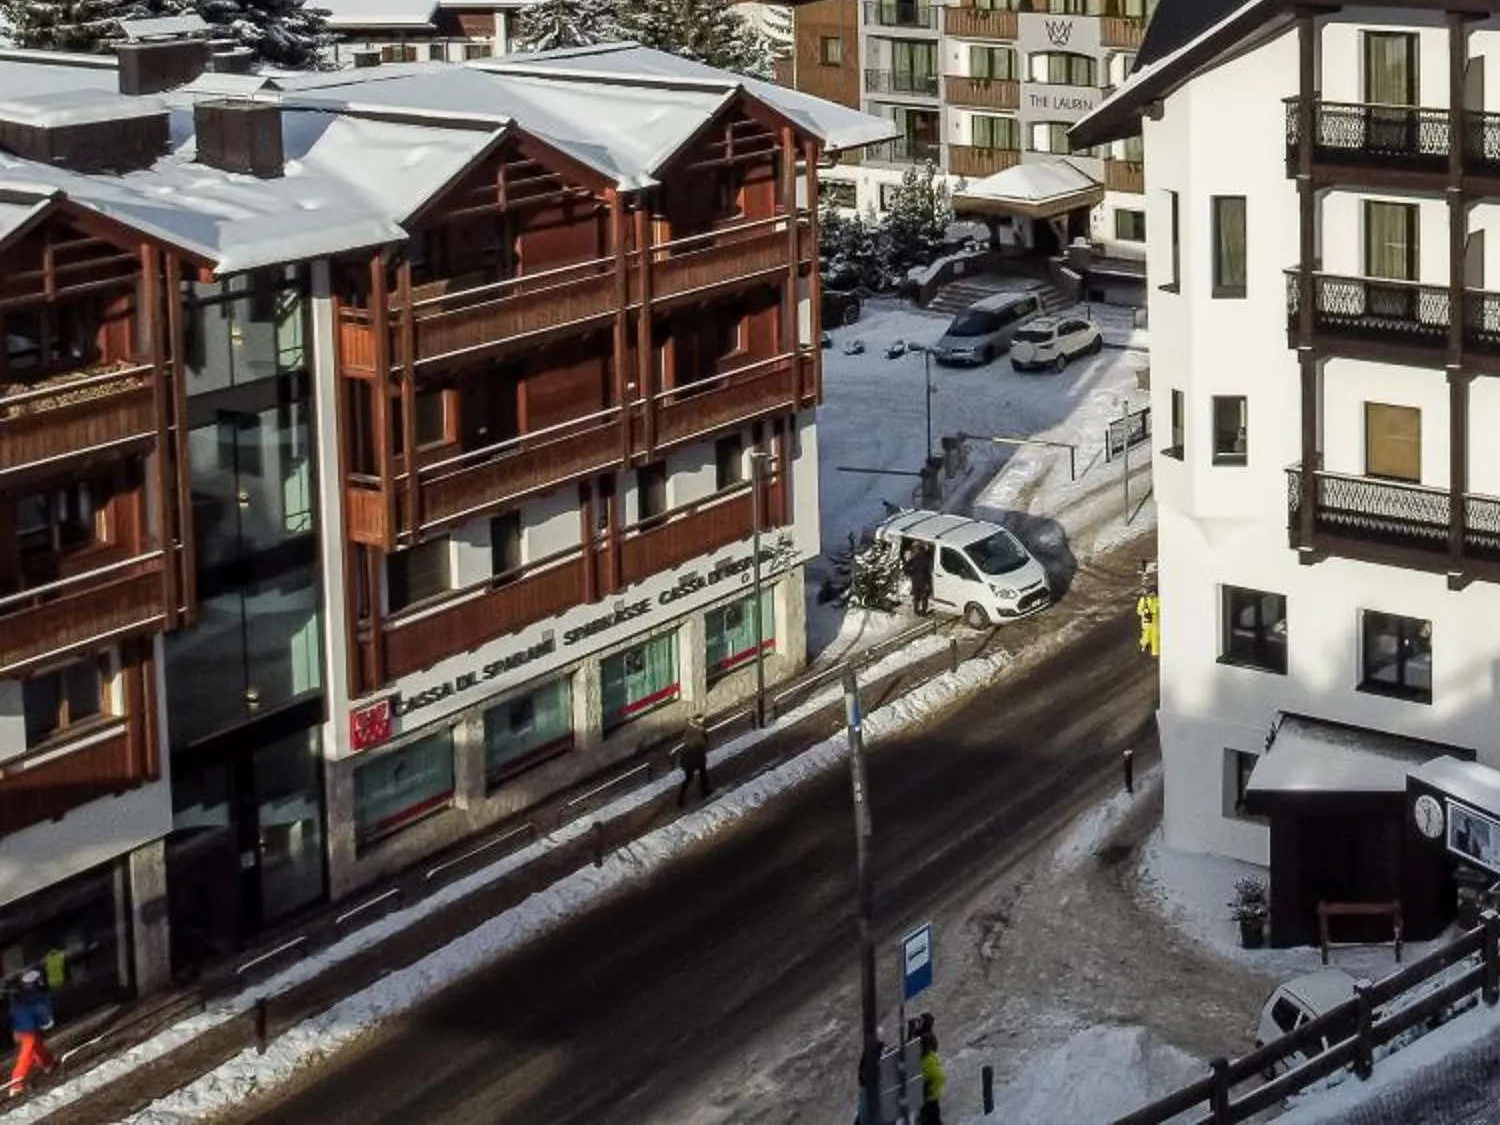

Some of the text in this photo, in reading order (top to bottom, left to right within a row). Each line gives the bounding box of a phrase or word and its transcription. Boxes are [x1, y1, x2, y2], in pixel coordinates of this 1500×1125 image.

[1030, 94, 1093, 111] THE LAURIN
[658, 575, 708, 605] CASSA
